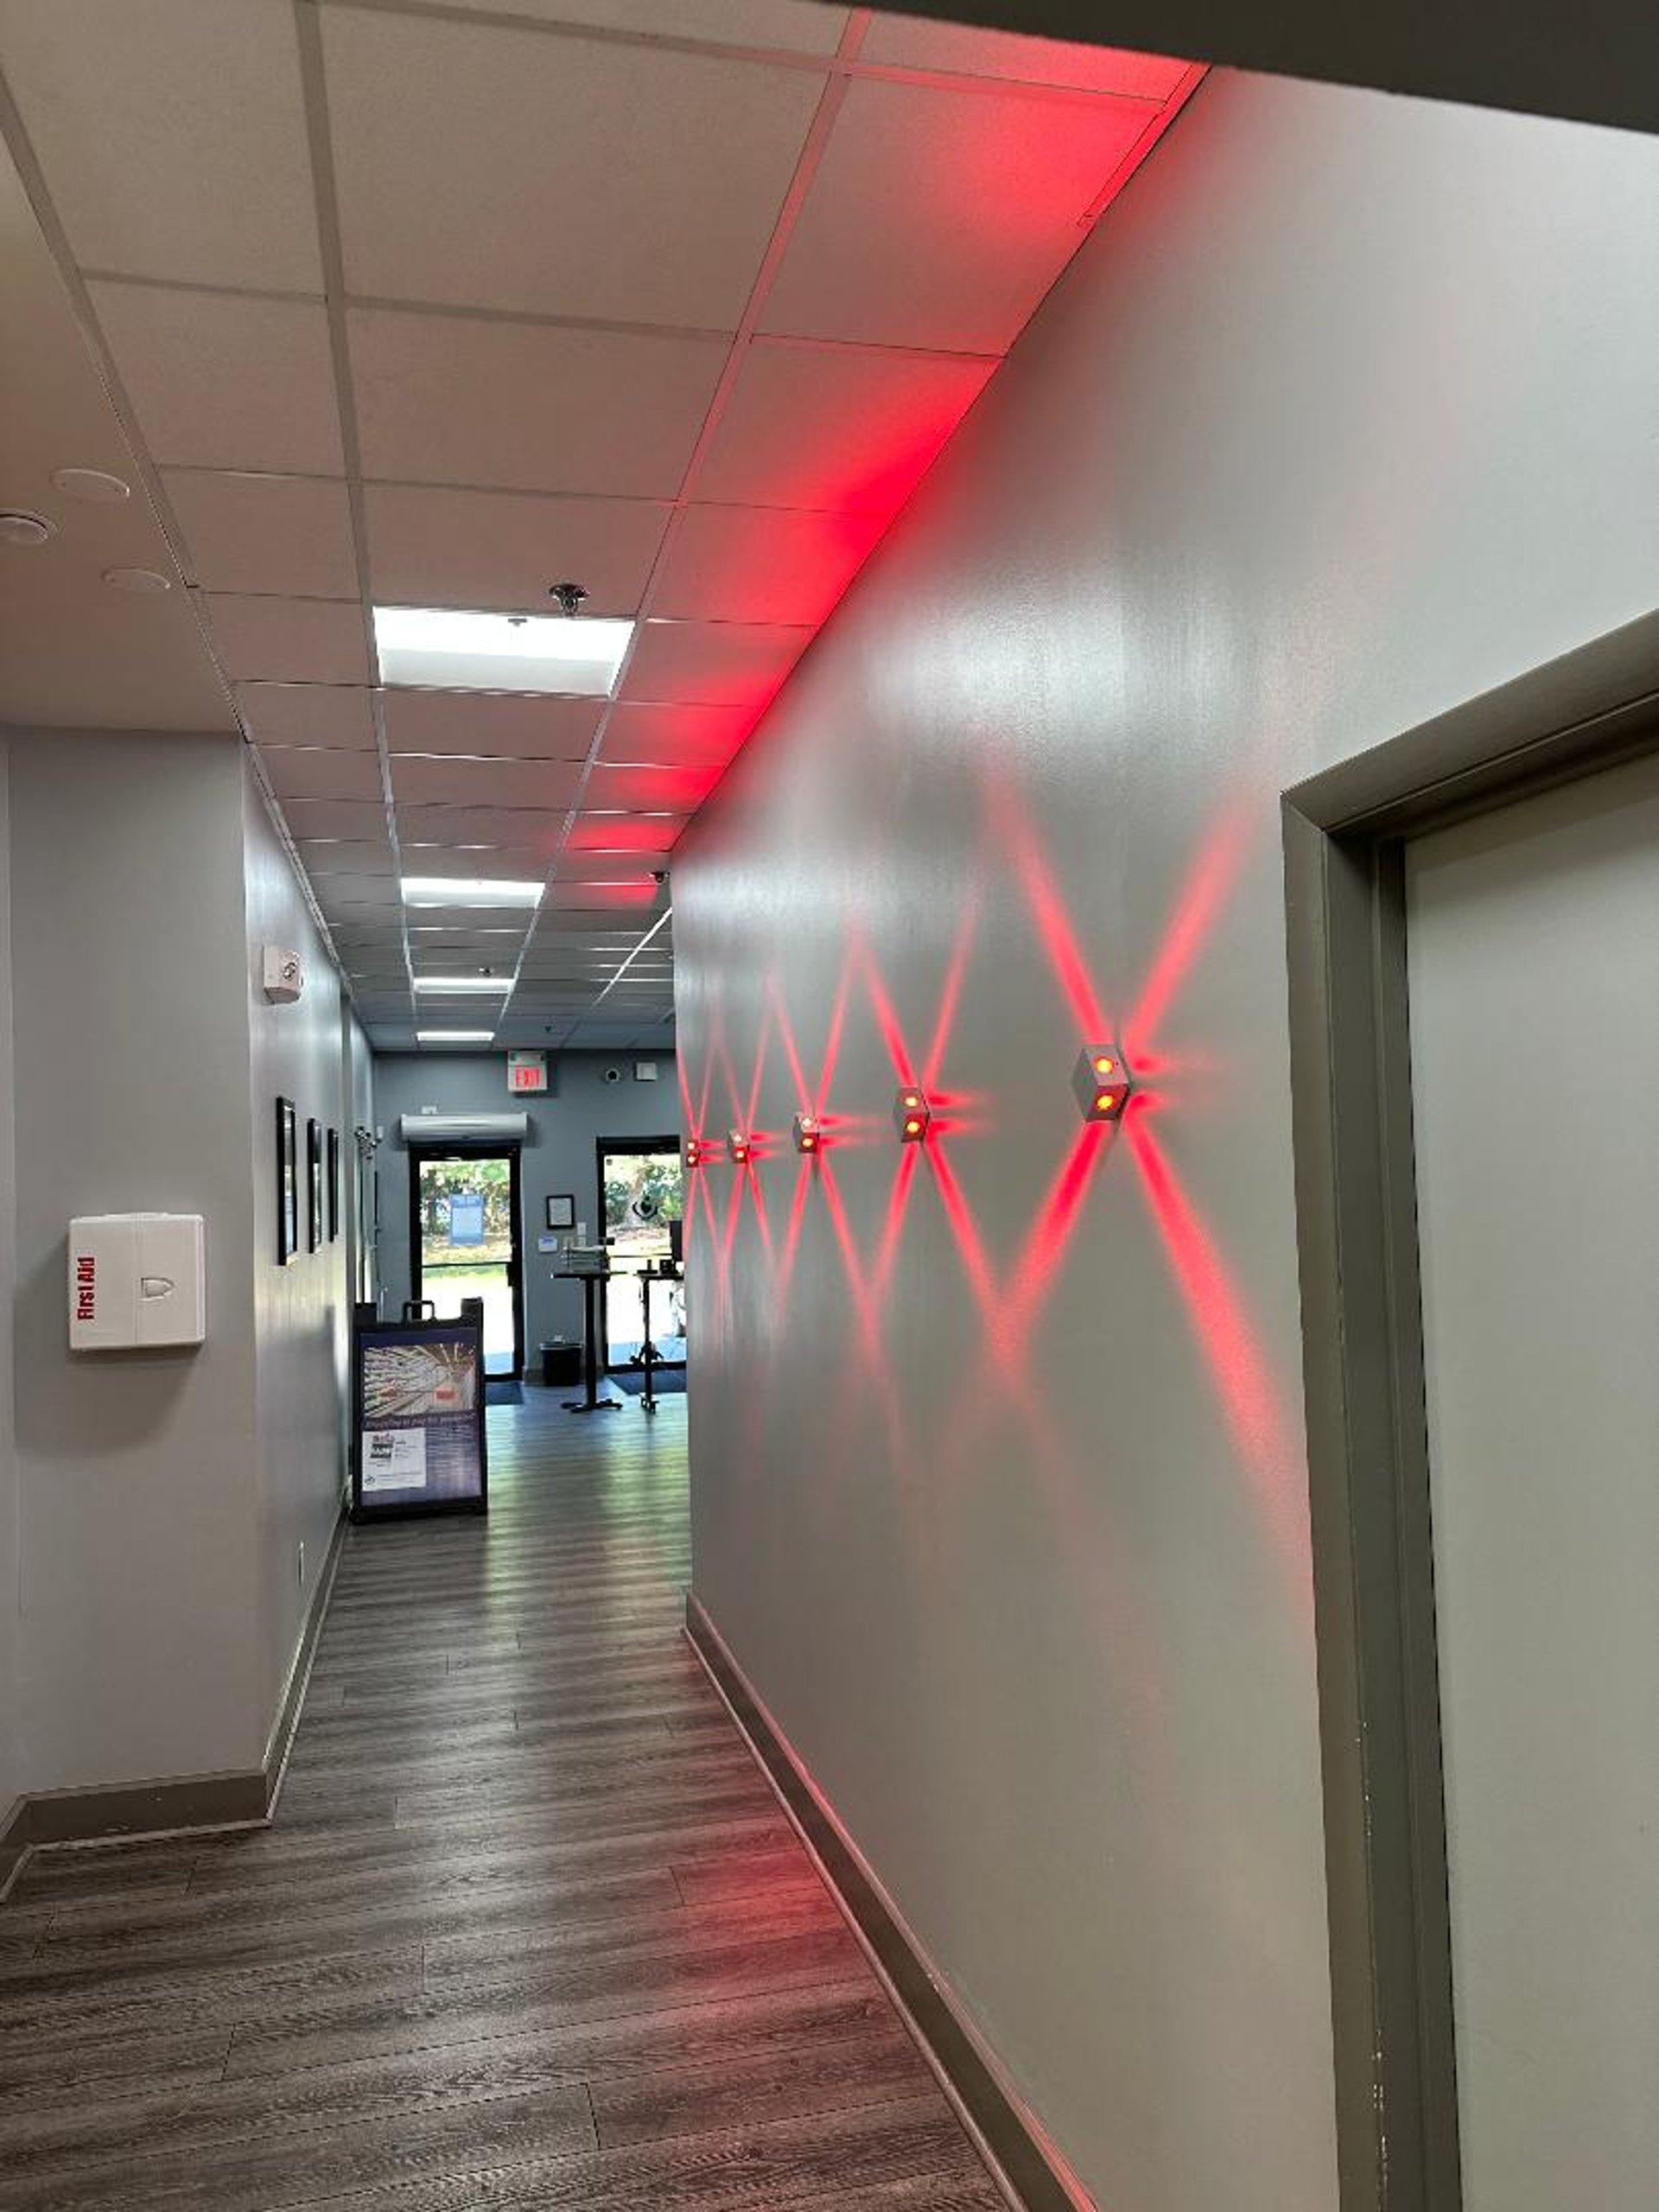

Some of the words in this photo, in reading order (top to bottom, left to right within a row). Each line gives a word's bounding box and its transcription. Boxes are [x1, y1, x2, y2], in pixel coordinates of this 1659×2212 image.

[516, 1067, 540, 1087] EXIT
[77, 1257, 95, 1283] Aid
[77, 1285, 95, 1320] First
